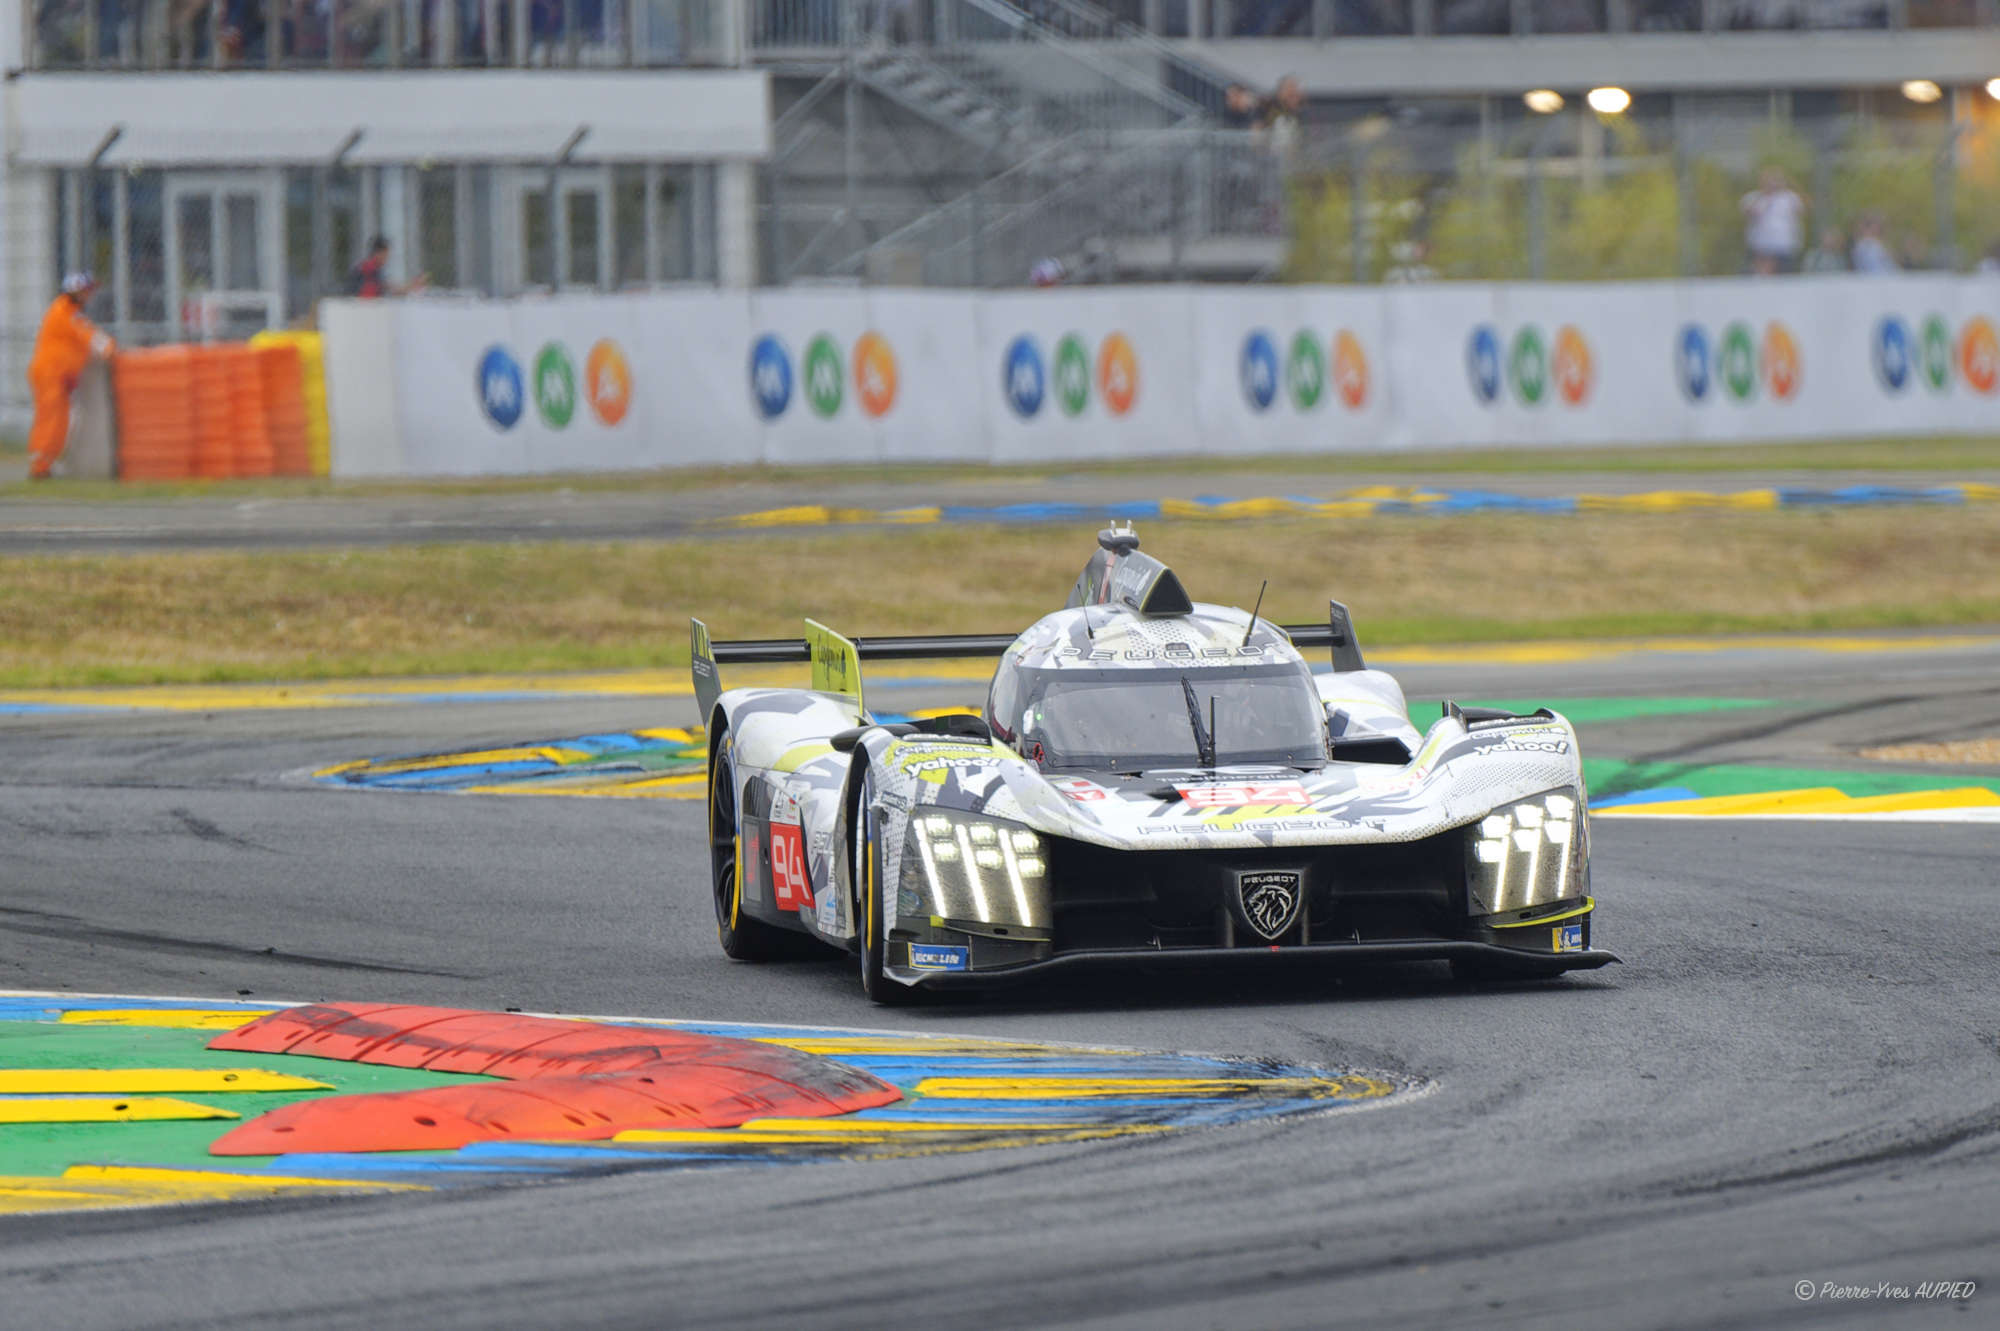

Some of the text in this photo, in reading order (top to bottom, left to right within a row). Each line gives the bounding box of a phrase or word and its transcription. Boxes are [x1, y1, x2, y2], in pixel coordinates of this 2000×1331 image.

[1058, 642, 1281, 662] PEUGEOT
[1474, 740, 1569, 756] yahoo!
[904, 756, 1001, 779] yahoo!
[1186, 787, 1310, 807] 94
[1136, 818, 1388, 836] PEUGEOT
[772, 834, 811, 900] 94
[1243, 875, 1297, 884] PEUGEOT
